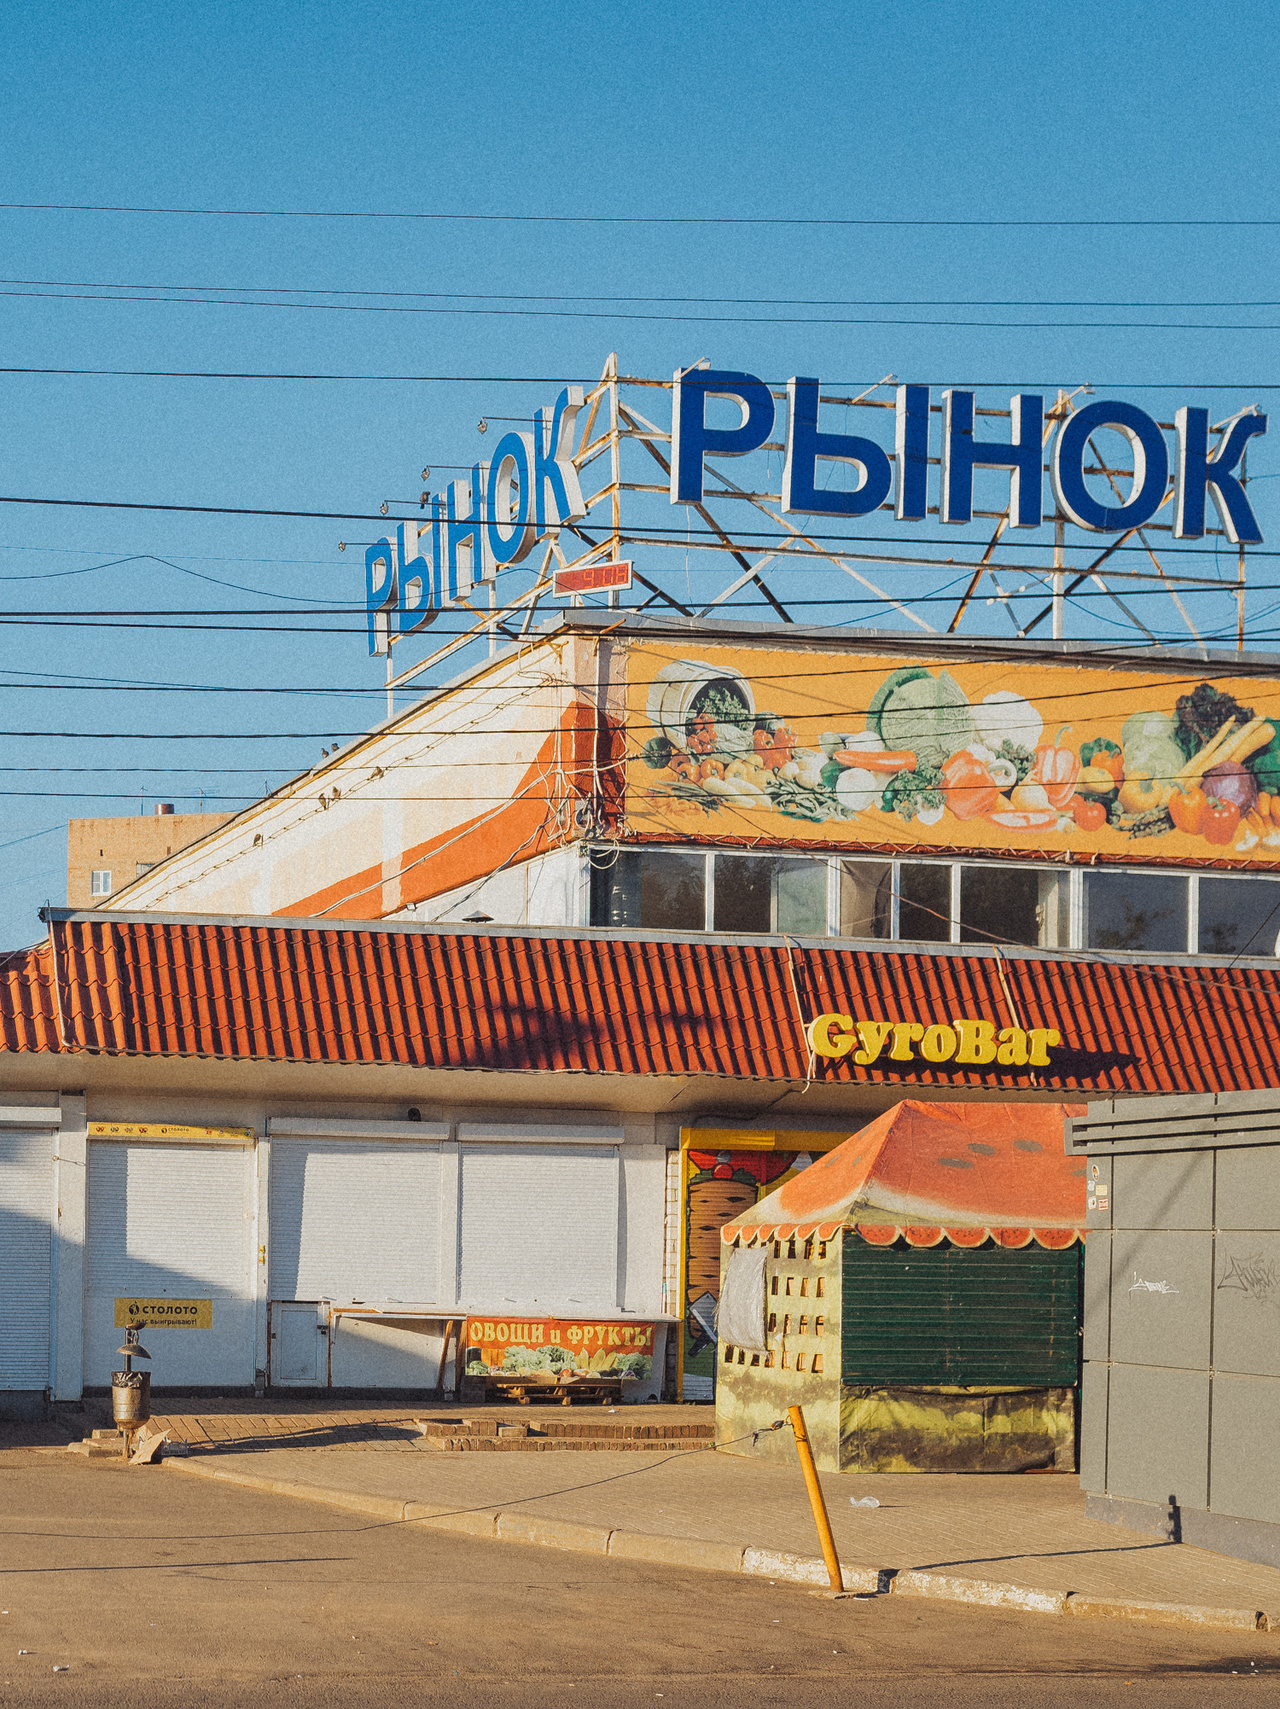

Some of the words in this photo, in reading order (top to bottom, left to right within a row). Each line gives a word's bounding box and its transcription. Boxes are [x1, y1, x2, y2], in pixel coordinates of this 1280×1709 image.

[670, 367, 1268, 545] РЫНОК
[365, 385, 587, 657] РЫНОК
[807, 1012, 1061, 1067] GyroBar
[471, 1321, 544, 1345] ОВОЩИ
[550, 1329, 561, 1343] и
[566, 1325, 652, 1346] ФРУКТЫ
